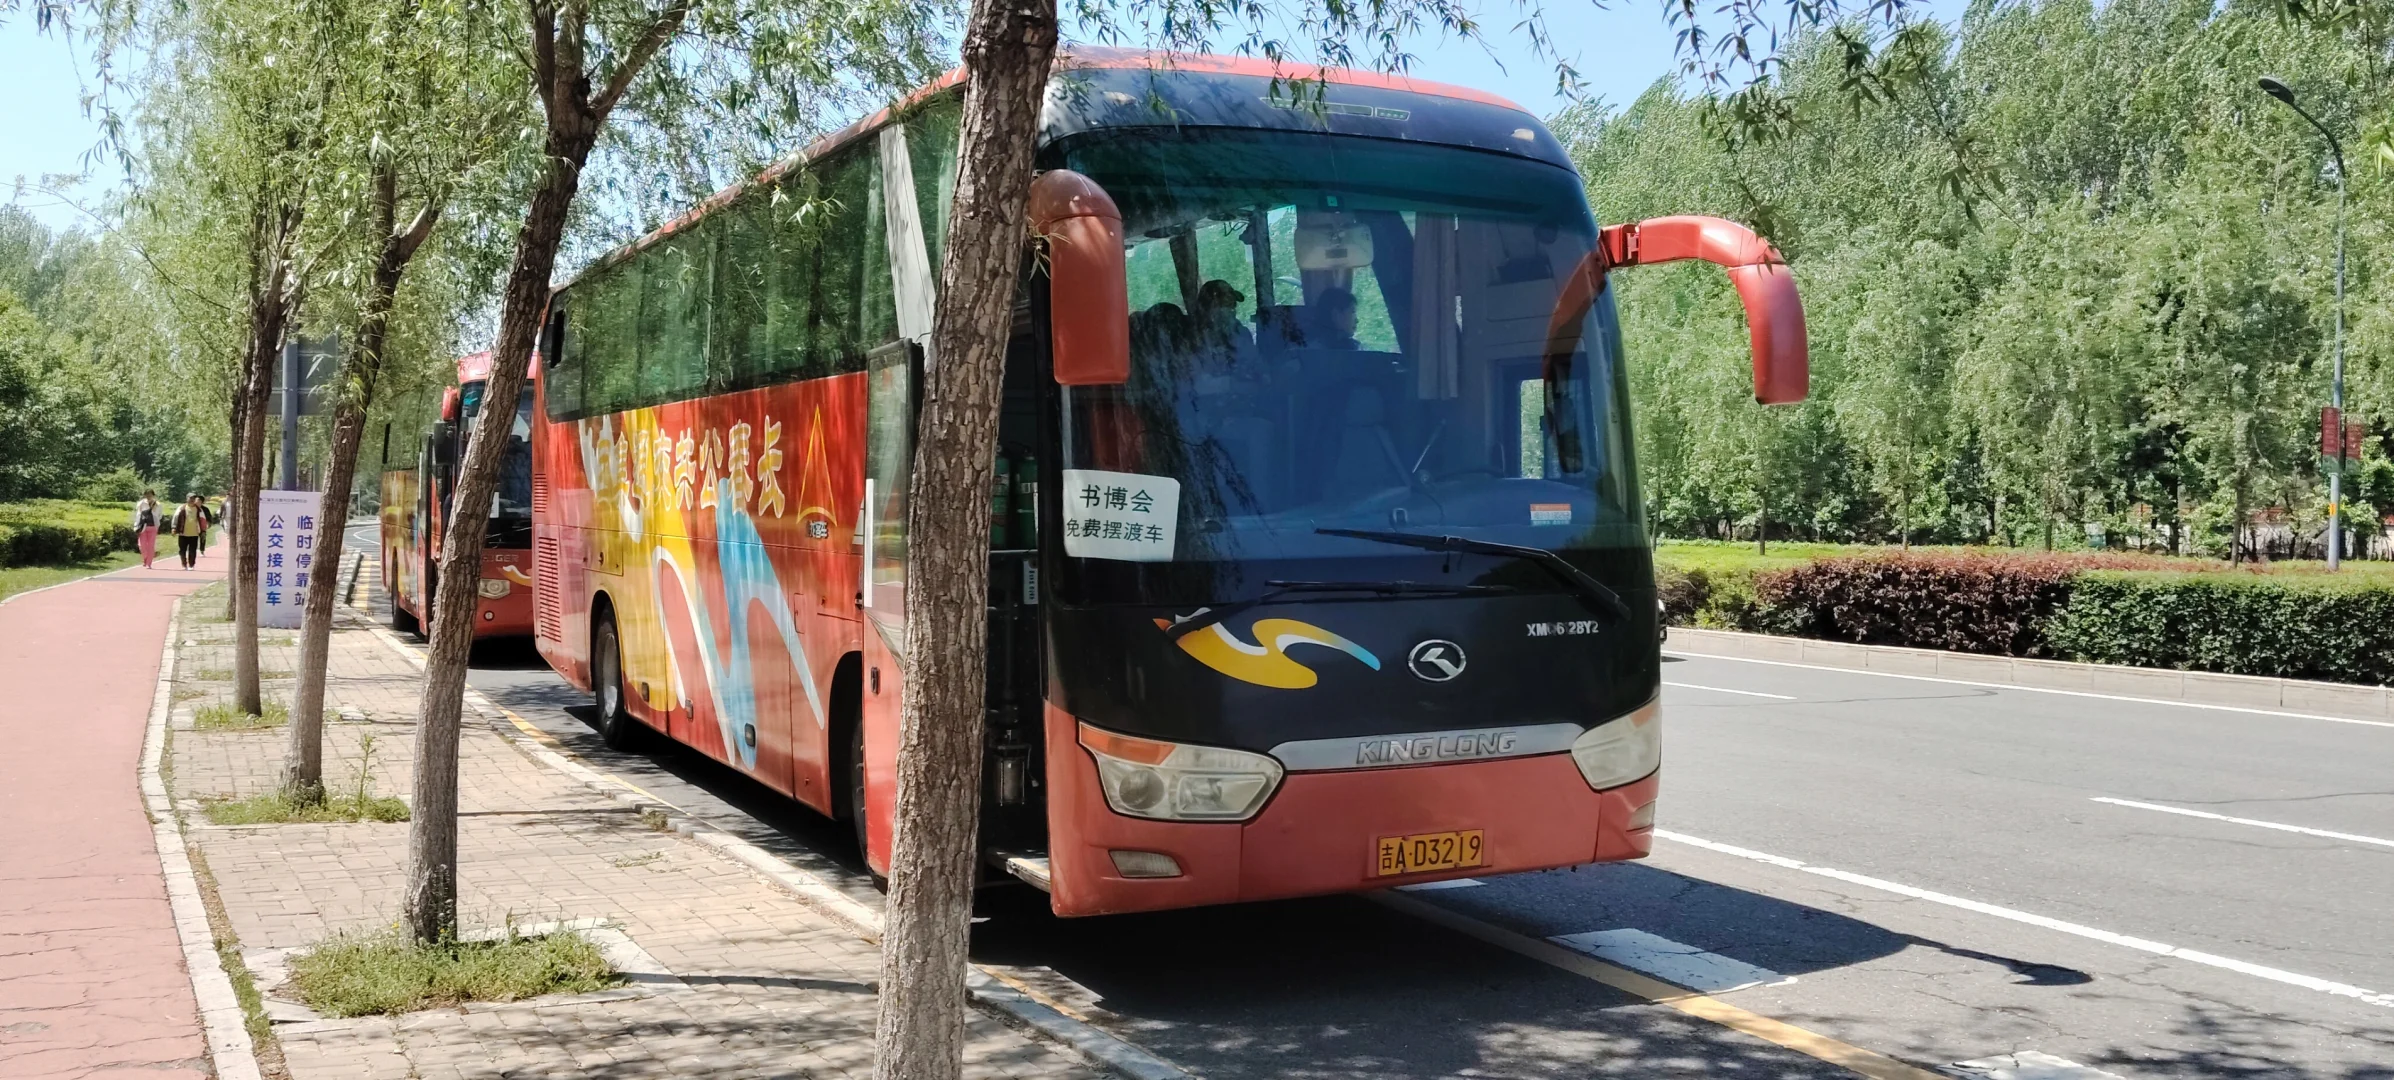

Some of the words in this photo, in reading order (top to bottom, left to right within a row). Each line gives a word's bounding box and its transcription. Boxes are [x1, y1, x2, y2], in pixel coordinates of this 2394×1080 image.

[1079, 484, 1154, 514] 书博会
[1066, 518, 1164, 544] 免费摆渡车
[266, 514, 285, 606] 公交接驳车
[294, 515, 314, 607] 临时停靠站
[1526, 620, 1600, 637] XM628Y2
[1356, 737, 1434, 765] KING
[1437, 731, 1517, 759] LONG
